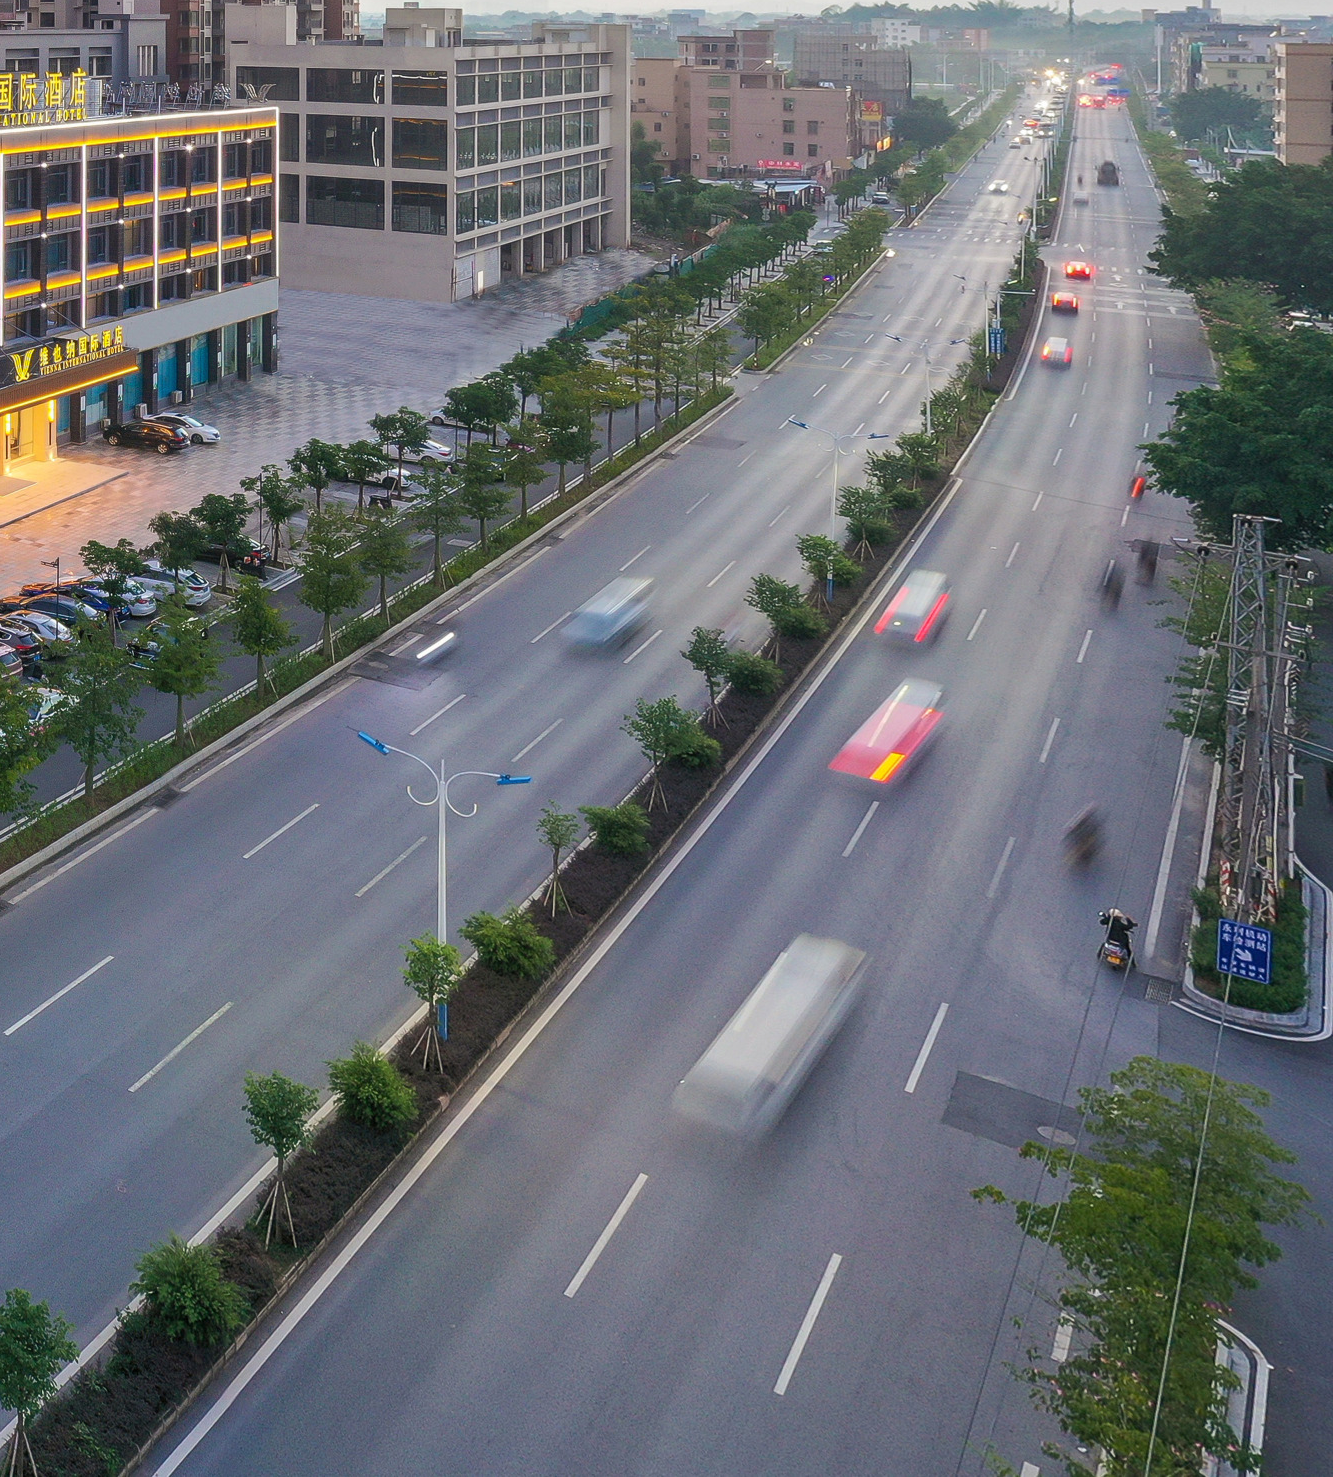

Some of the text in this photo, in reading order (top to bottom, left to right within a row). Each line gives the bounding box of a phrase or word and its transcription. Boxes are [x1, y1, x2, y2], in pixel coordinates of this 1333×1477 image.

[56, 107, 88, 123] HOTEL
[39, 325, 124, 367] 维也纳国际酒店
[40, 345, 124, 376] VIENNA INTERNATIONAL HOTEL
